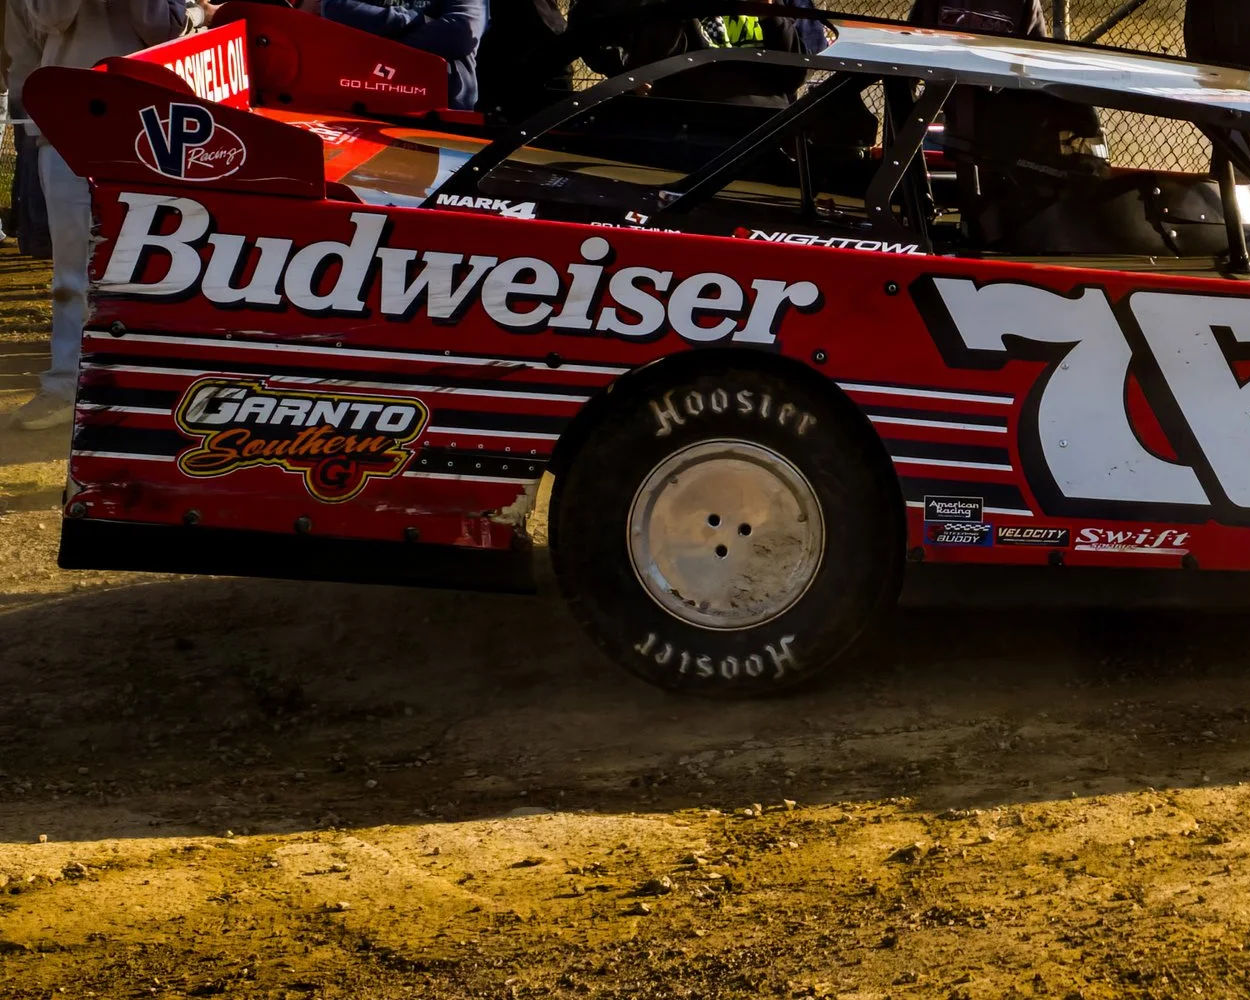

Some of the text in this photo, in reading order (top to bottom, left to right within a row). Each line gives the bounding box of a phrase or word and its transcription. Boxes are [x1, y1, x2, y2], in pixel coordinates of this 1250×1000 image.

[227, 36, 249, 95] OIL
[340, 78, 427, 96] GO LITHIUM
[139, 102, 215, 178] VP
[187, 145, 243, 169] Racing
[749, 229, 927, 256] NIGHTOWL
[98, 192, 819, 345] Budweiser
[185, 386, 416, 432] GARNTO
[649, 388, 817, 437] Hoosier
[184, 424, 396, 468] Southern
[929, 500, 979, 510] American
[936, 506, 971, 518] Racing
[937, 535, 980, 543] BUDDY
[998, 528, 1067, 539] VELOCITY
[634, 633, 800, 679] Hoosier
